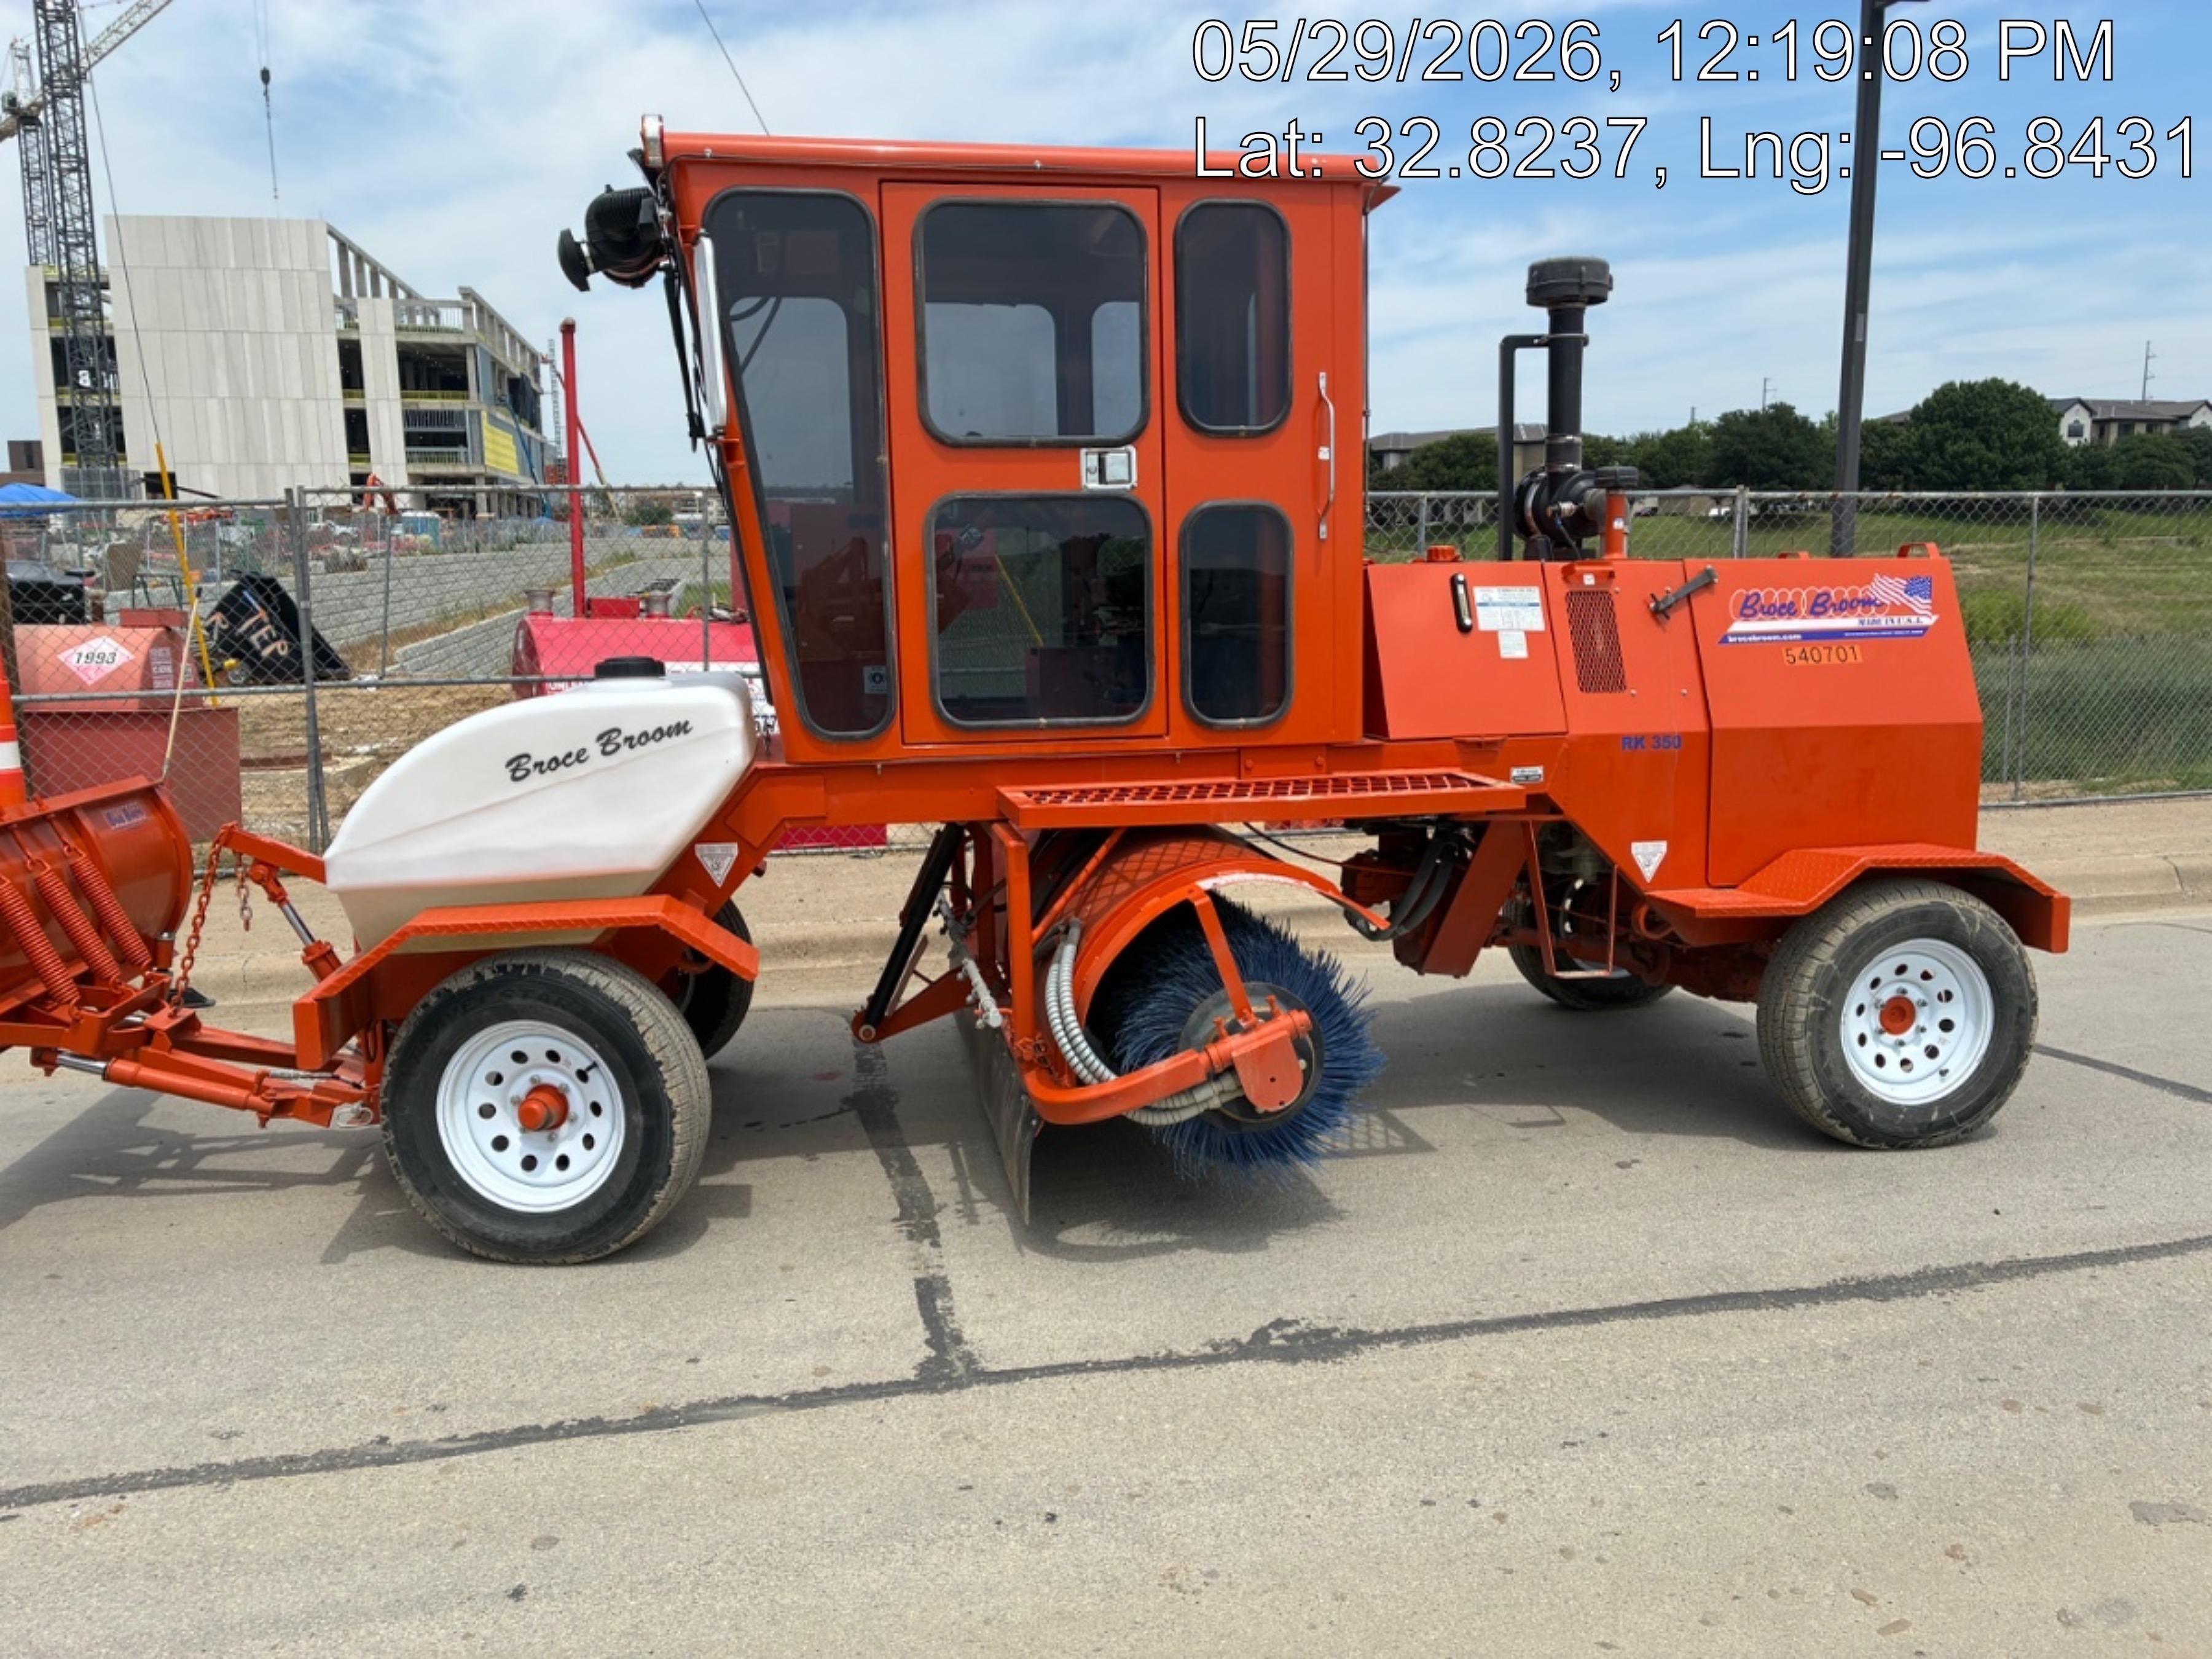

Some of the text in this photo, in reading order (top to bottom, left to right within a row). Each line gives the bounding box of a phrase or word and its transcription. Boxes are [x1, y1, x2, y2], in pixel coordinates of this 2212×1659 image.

[1740, 590, 1885, 618] Broce Broom
[74, 651, 117, 664] 1993
[1785, 646, 1859, 664] 540701
[504, 720, 693, 782] Broce Broom
[1622, 735, 1682, 750] RK 350
